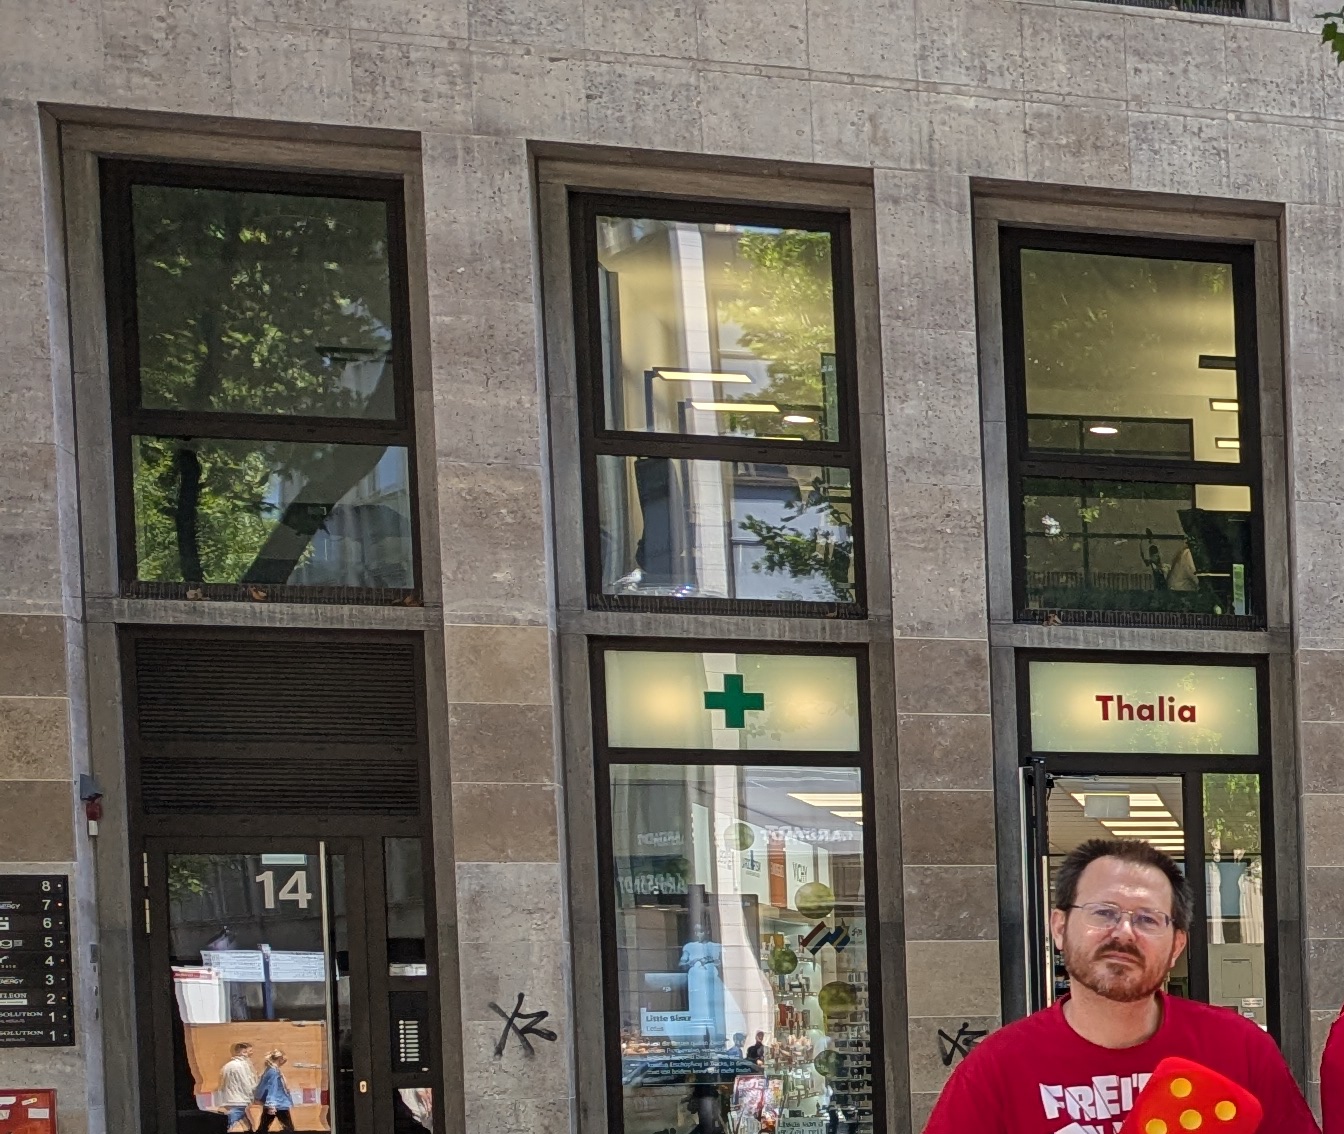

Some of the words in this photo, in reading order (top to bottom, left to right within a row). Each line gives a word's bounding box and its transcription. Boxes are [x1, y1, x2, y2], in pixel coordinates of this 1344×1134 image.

[1095, 695, 1197, 723] Thalia
[41, 880, 51, 892] 8
[255, 870, 313, 909] 14
[42, 899, 51, 911] 7
[42, 917, 52, 929] 6
[44, 936, 53, 948] 5
[44, 955, 54, 967] 4
[45, 974, 54, 985] 3
[46, 993, 56, 1005] 2
[48, 1011, 55, 1023] 1
[49, 1030, 56, 1042] 1
